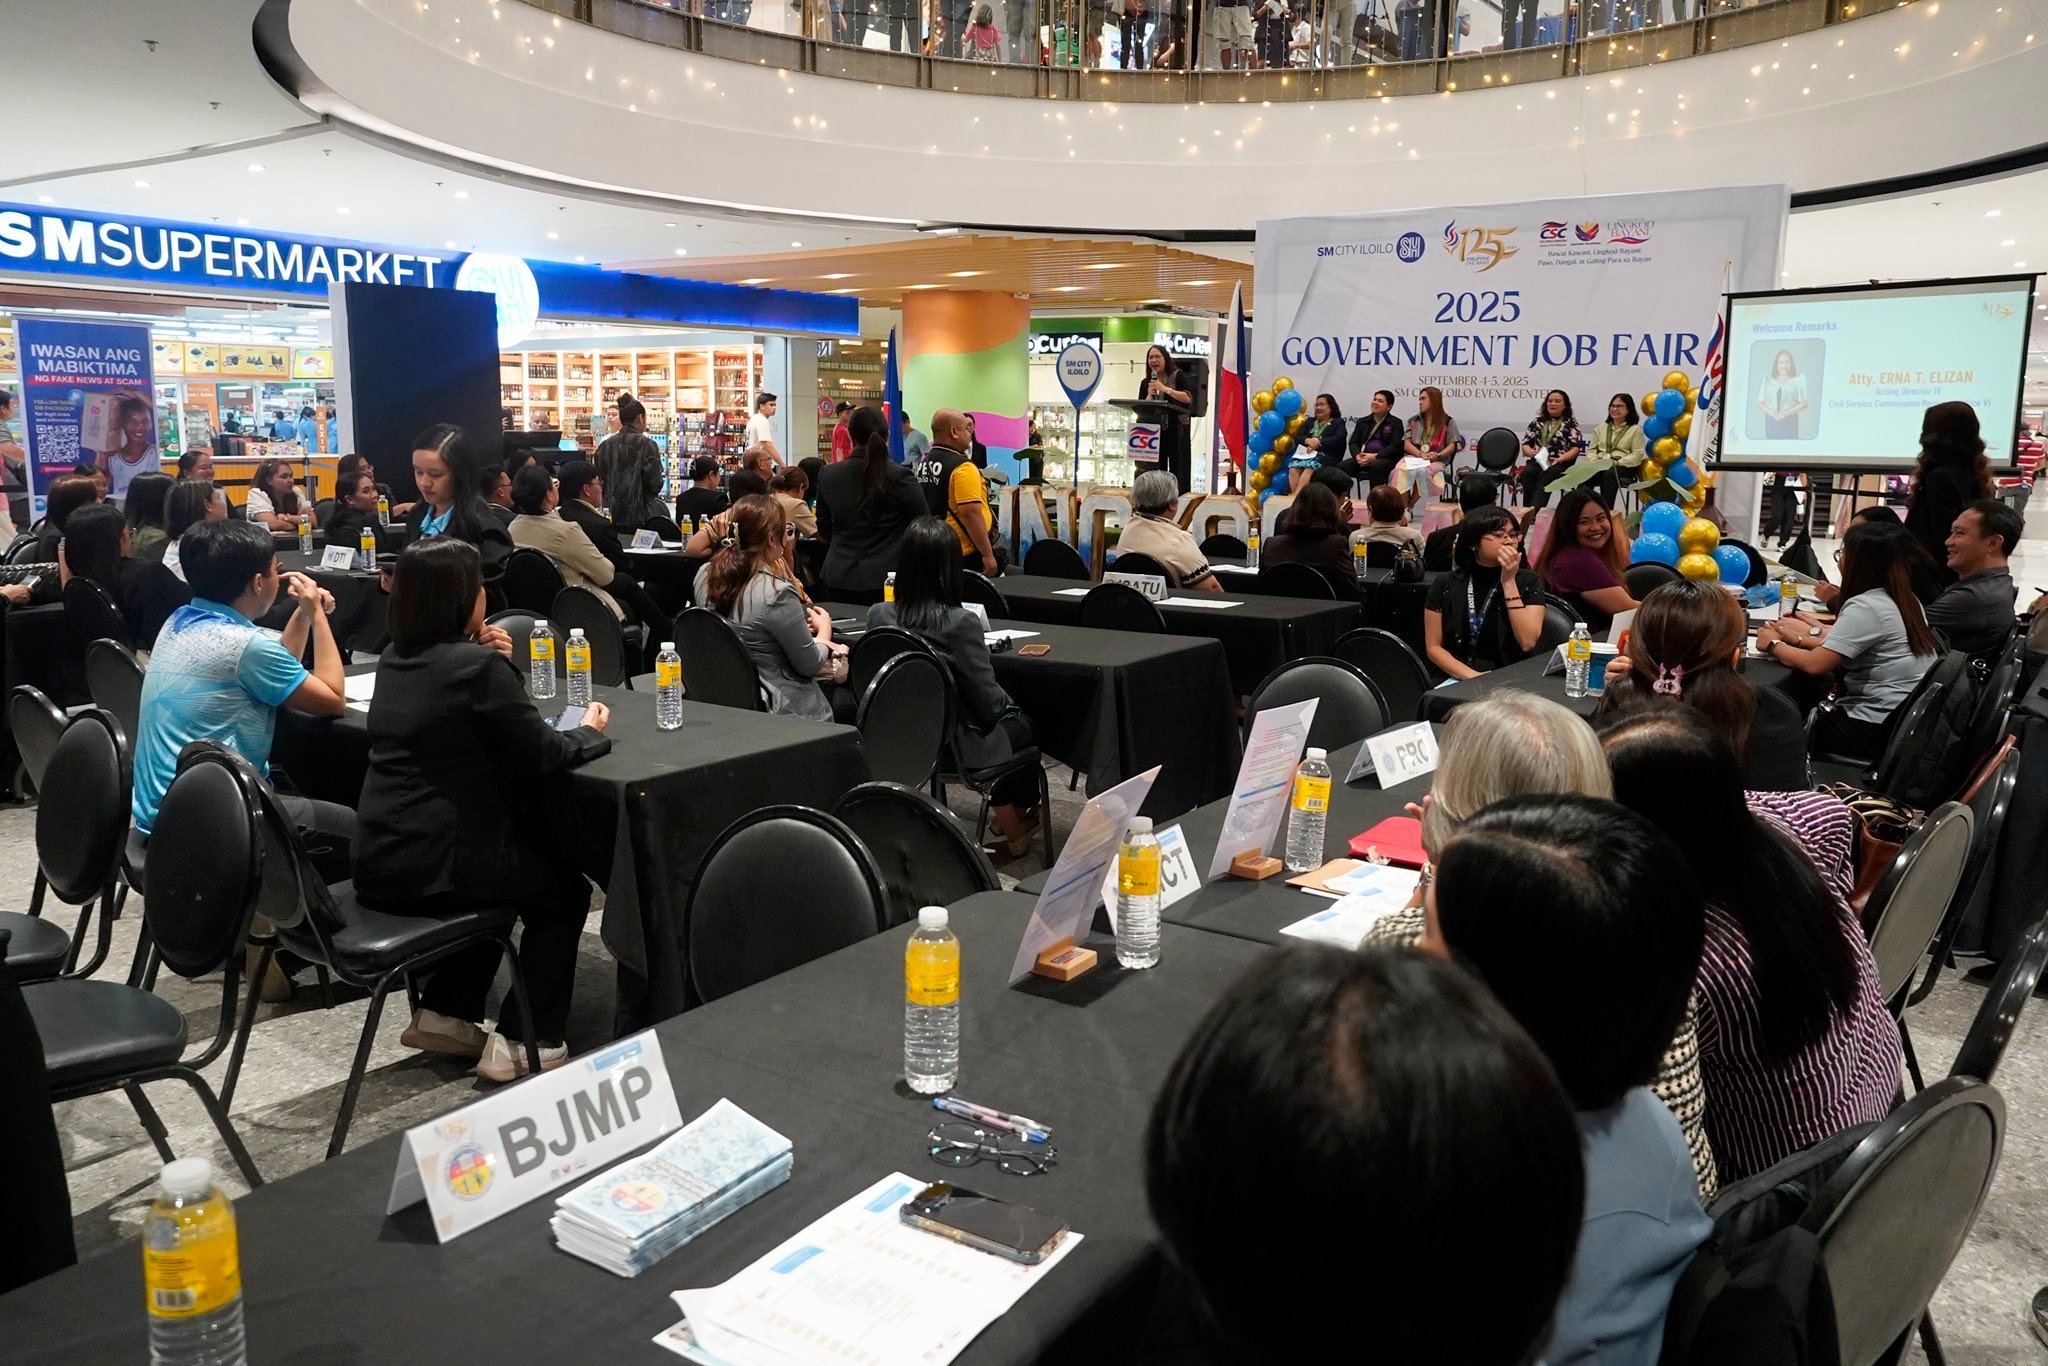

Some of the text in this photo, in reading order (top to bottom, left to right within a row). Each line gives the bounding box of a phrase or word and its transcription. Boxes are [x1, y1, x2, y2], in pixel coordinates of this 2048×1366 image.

[1540, 228, 1568, 239] CSC
[1317, 242, 1394, 257] SM CITY ILOILO
[1608, 256, 1622, 264] Para
[1632, 256, 1652, 264] Bayan
[1435, 291, 1520, 323] 2025
[1752, 320, 1838, 333] Welcome Remarks
[31, 344, 141, 361] IWASAN ANG
[1282, 333, 1700, 368] GOVERNMENT JOB FAIR
[38, 359, 138, 376] MABIKTIMA
[1067, 368, 1090, 376] ILOILO
[34, 375, 143, 386] NG FAKE NEWS AT SCAM
[1418, 376, 1477, 386] SEPTEMBER
[1502, 376, 1529, 386] 2025
[1849, 370, 1974, 387] Atty. ERNA T. ELIZAN
[1395, 388, 1409, 397] SM
[1475, 389, 1509, 398] EVENT
[1875, 386, 1942, 397] Acting Director IV
[1828, 400, 1845, 408] Civil
[1846, 400, 1873, 408] Service
[1874, 399, 1920, 408] Commission
[1129, 435, 1159, 449] CSC
[1395, 738, 1429, 771] PRC
[498, 1066, 652, 1178] BJMP
